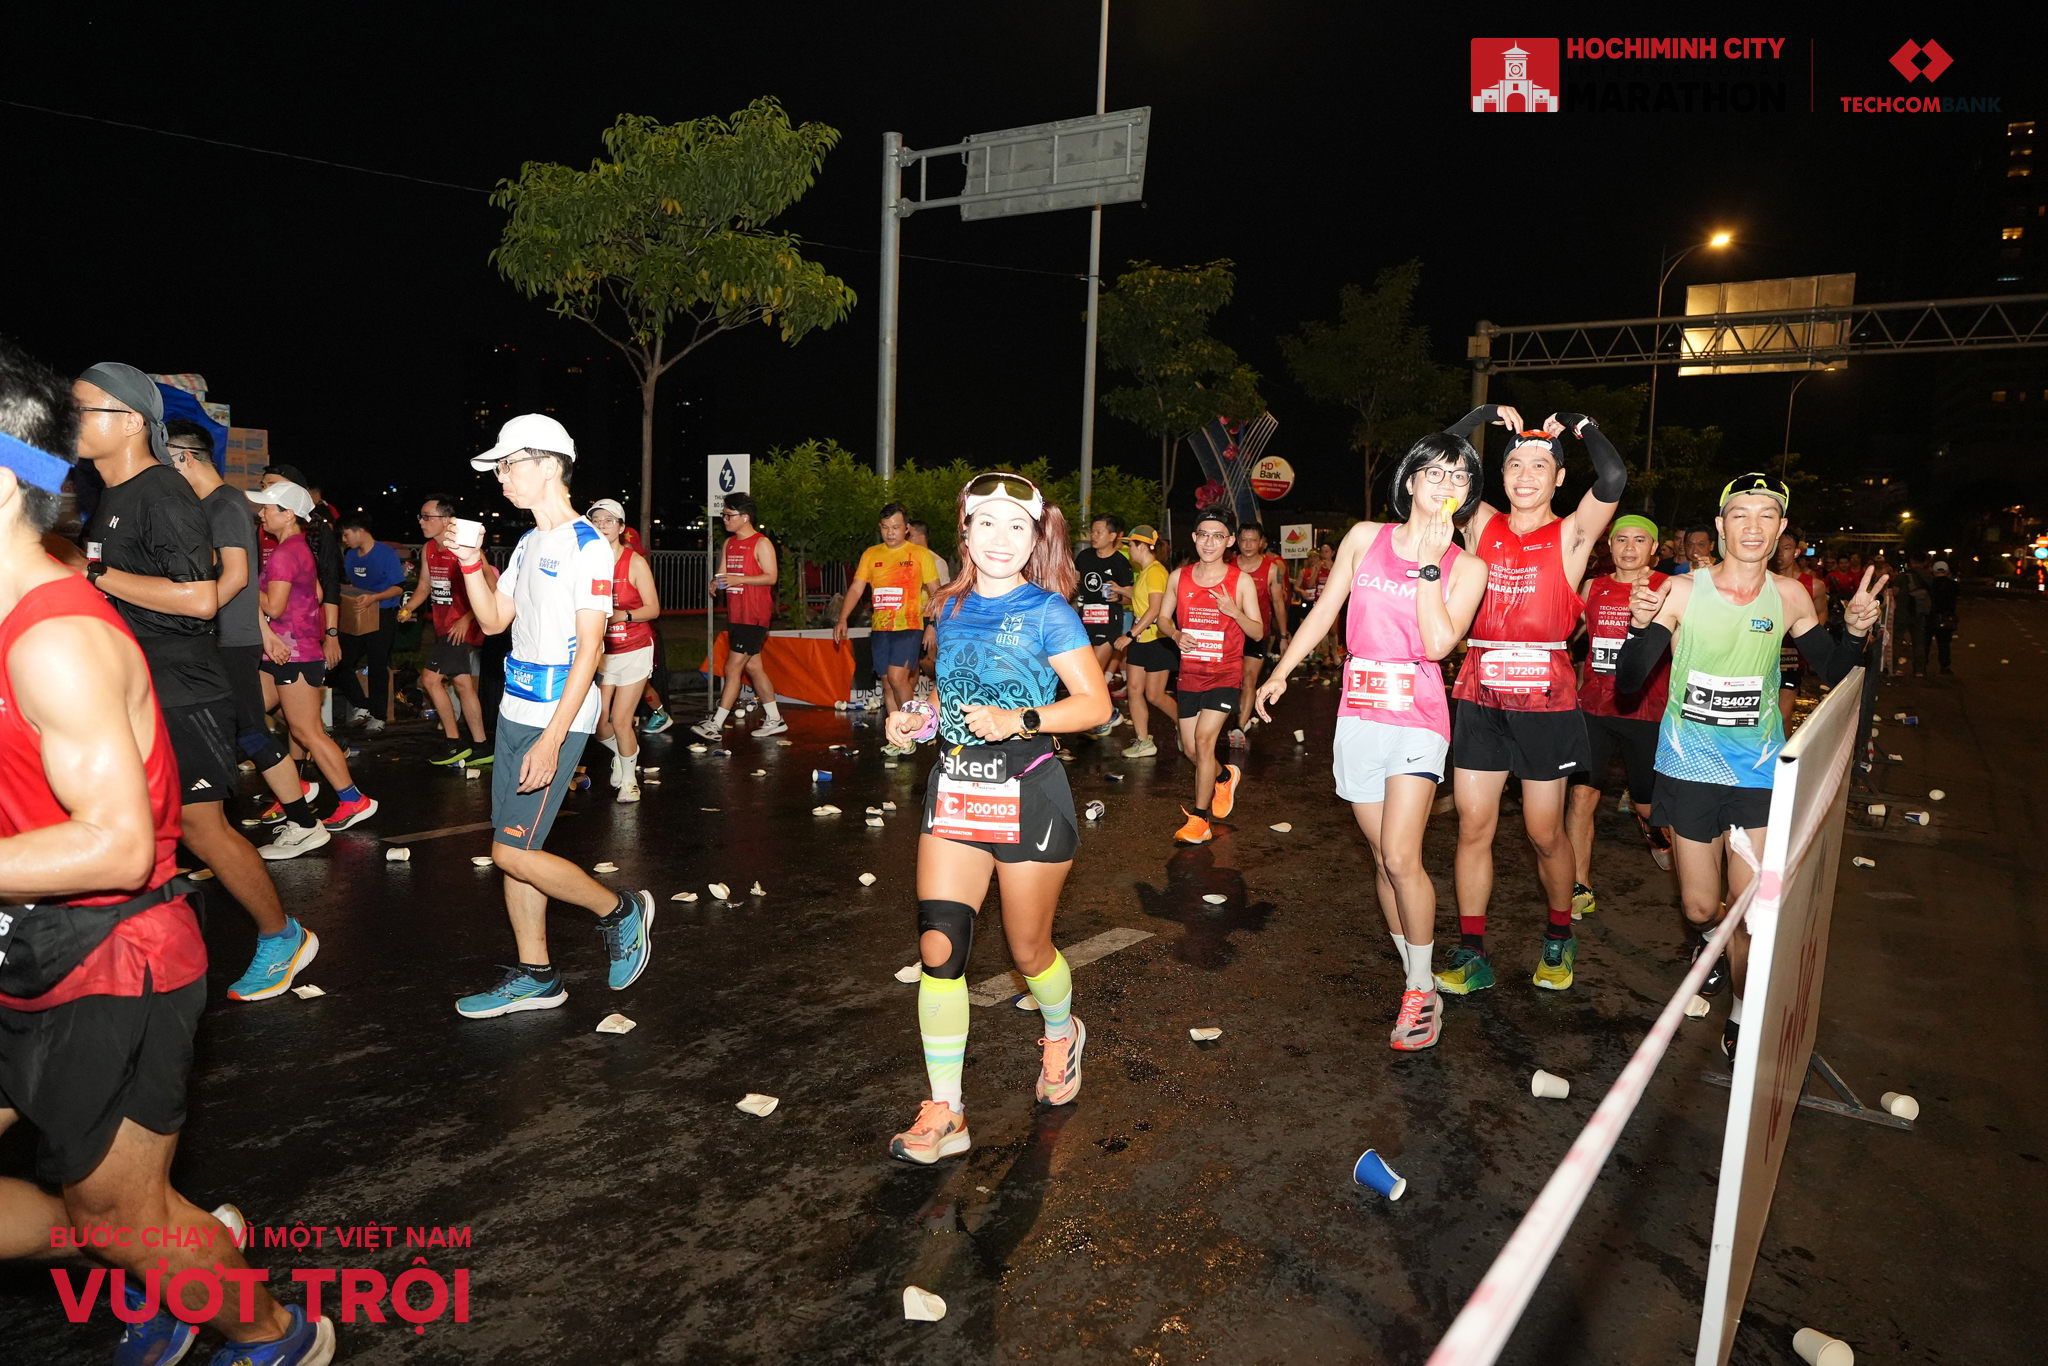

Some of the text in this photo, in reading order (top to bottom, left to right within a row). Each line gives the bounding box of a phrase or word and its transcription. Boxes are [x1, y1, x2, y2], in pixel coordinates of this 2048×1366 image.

[1261, 462, 1273, 470] HD
[1260, 470, 1281, 479] Bank
[1490, 563, 1538, 574] TECHCOMBANK
[1487, 582, 1536, 593] MARATHON
[996, 633, 1019, 645] OTSO
[1595, 649, 1605, 660] B
[1485, 664, 1547, 677] C 372017
[1352, 672, 1361, 687] E
[1691, 690, 1760, 707] C 354027
[943, 797, 1017, 816] C 200103
